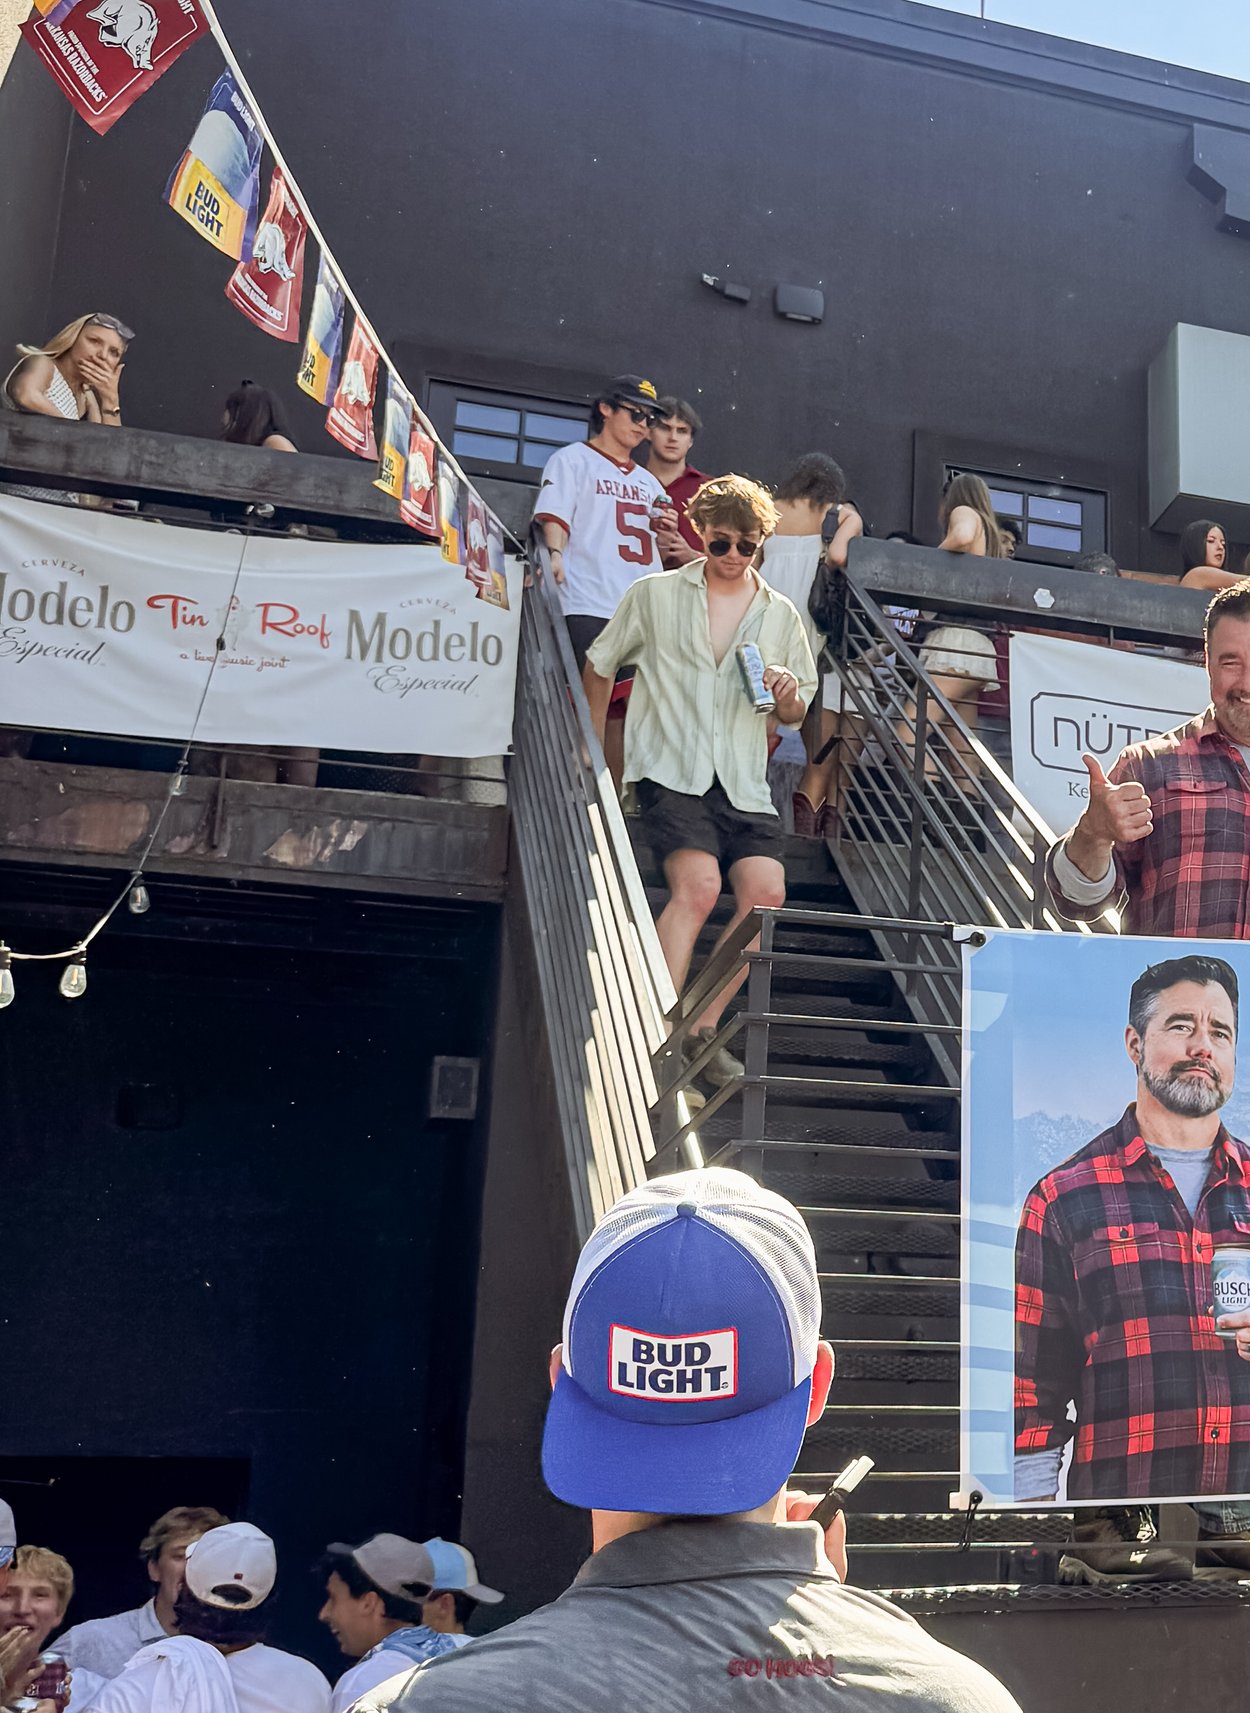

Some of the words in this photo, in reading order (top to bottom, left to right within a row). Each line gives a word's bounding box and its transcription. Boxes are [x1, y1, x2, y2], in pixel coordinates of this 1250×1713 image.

[67, 51, 105, 103] RAZORBACKS
[194, 180, 221, 216] BUD
[184, 193, 224, 238] LIGHT
[616, 501, 653, 566] 5
[21, 558, 86, 577] CERVEZA
[146, 594, 209, 630] Tin
[256, 603, 332, 649] Roof
[399, 597, 457, 615] CERVEZA
[0, 627, 106, 664] Especial
[344, 608, 503, 666] Modelo
[256, 656, 290, 672] joint
[366, 665, 480, 699] Especial
[1067, 781, 1089, 799] Ke
[1221, 1296, 1248, 1304] LIGHT
[632, 1337, 712, 1367] BUD
[617, 1362, 728, 1394] LIGHT
